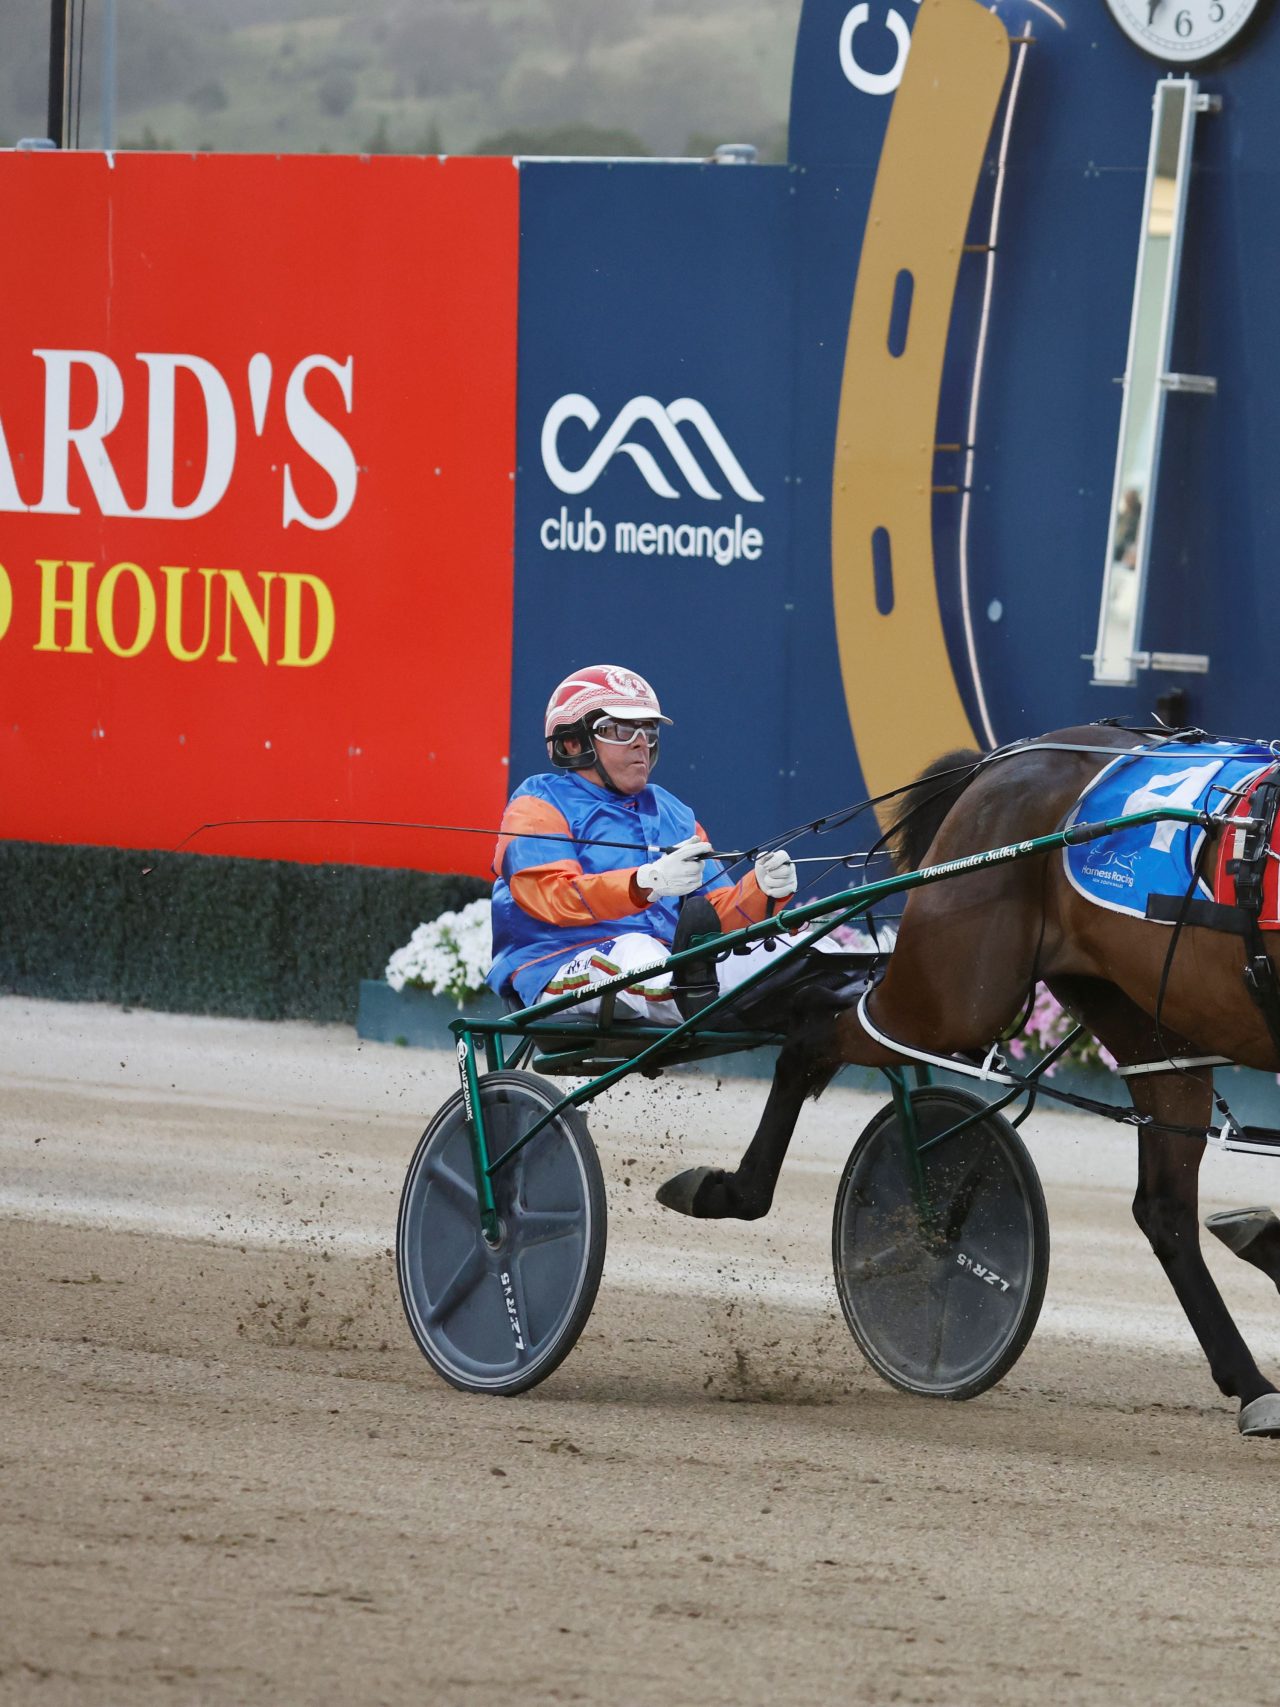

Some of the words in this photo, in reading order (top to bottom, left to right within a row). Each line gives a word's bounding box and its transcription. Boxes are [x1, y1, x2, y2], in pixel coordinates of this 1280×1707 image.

[1175, 9, 1193, 38] 6
[0, 348, 358, 532] RD'S
[540, 505, 606, 553] club
[615, 513, 763, 566] menangle
[32, 559, 336, 668] HOUND
[1121, 759, 1225, 854] 4
[920, 855, 984, 879] Downunder
[985, 846, 1018, 862] Sulky
[1081, 864, 1112, 880] Harness
[1111, 871, 1134, 888] Racing
